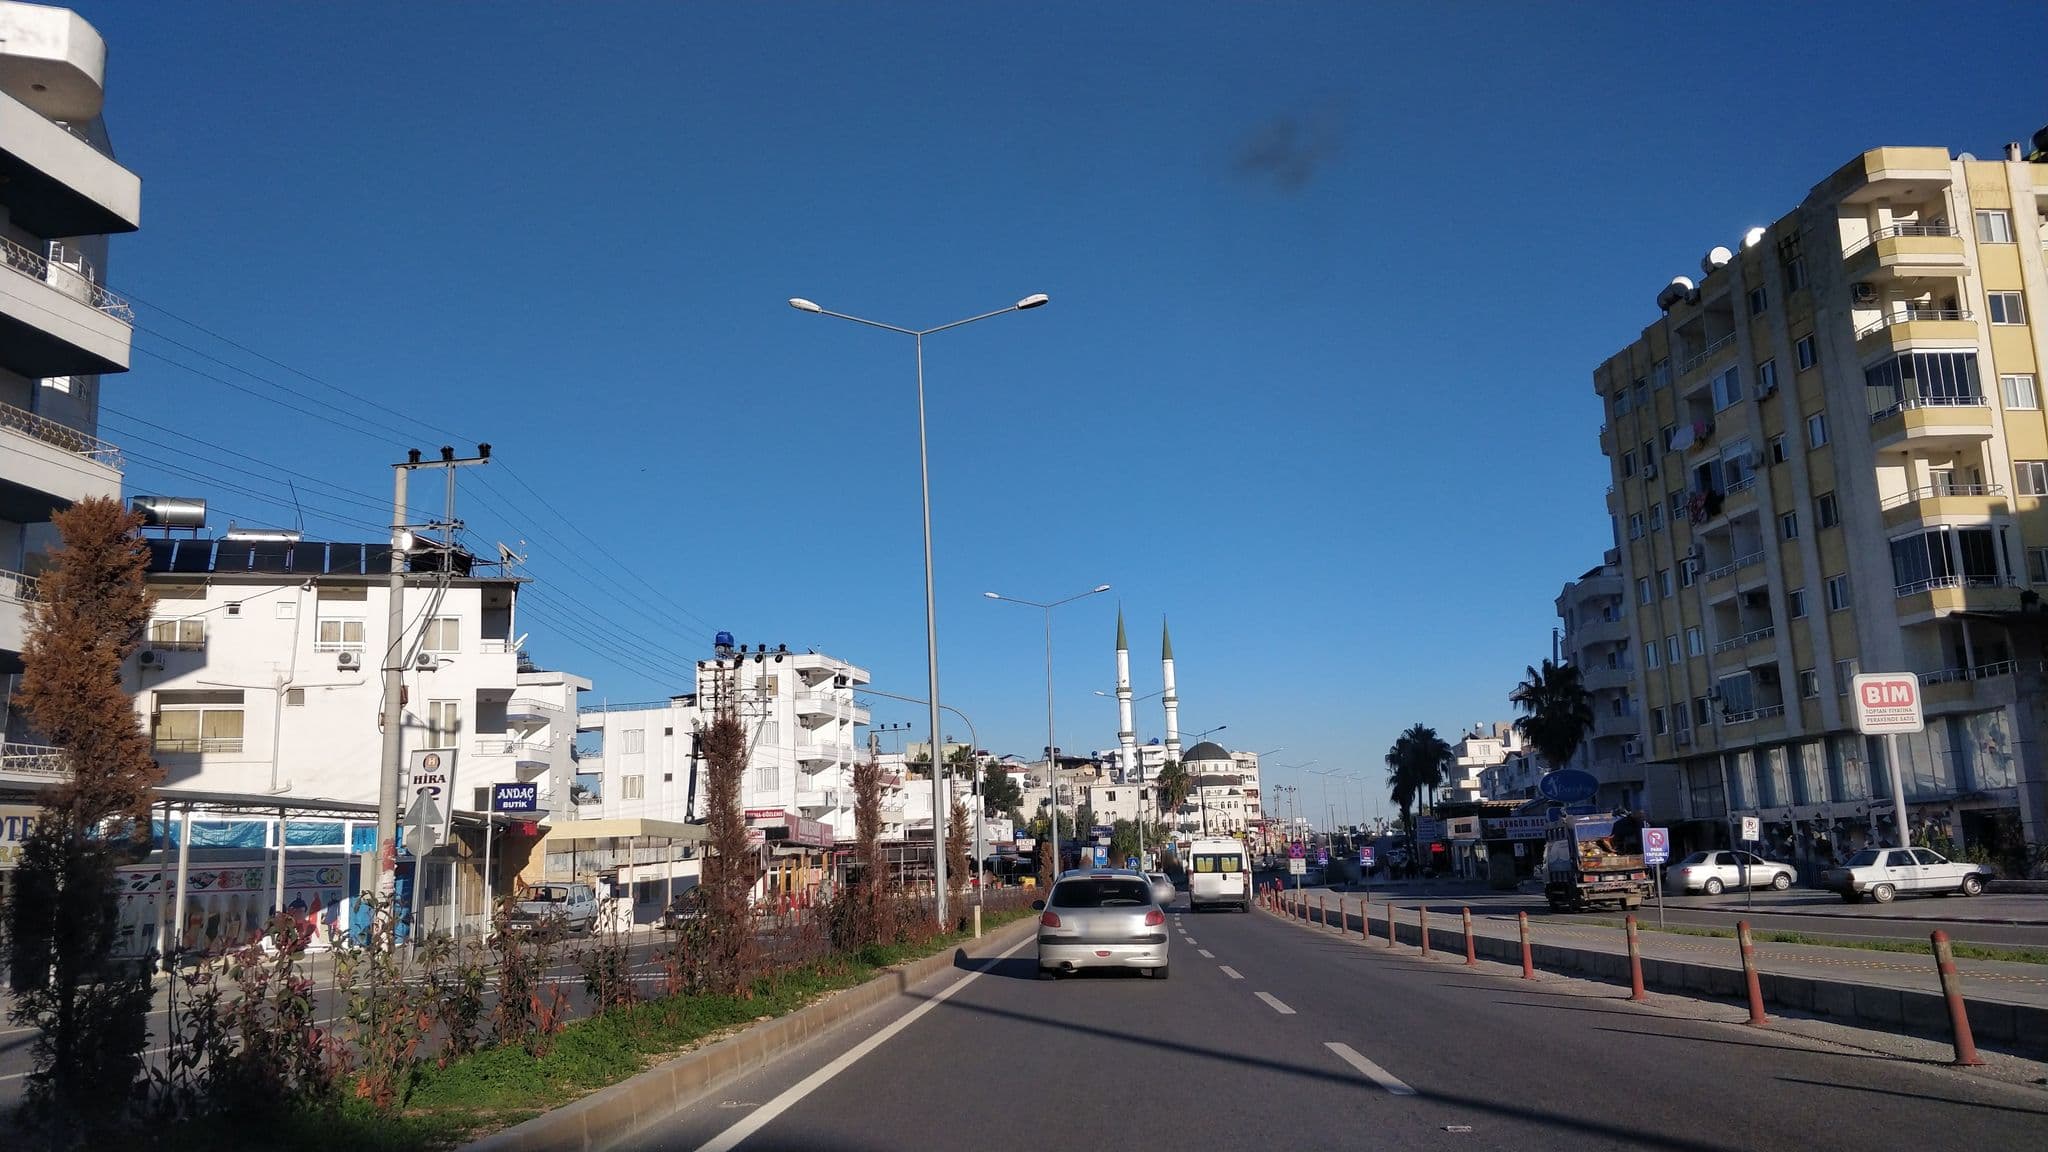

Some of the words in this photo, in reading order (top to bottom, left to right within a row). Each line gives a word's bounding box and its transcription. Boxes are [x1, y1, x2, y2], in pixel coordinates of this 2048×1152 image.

[1866, 681, 1910, 704] BİM
[413, 773, 446, 785] HİRA
[497, 787, 535, 801] ANDAÇ
[502, 800, 528, 809] BUTİK
